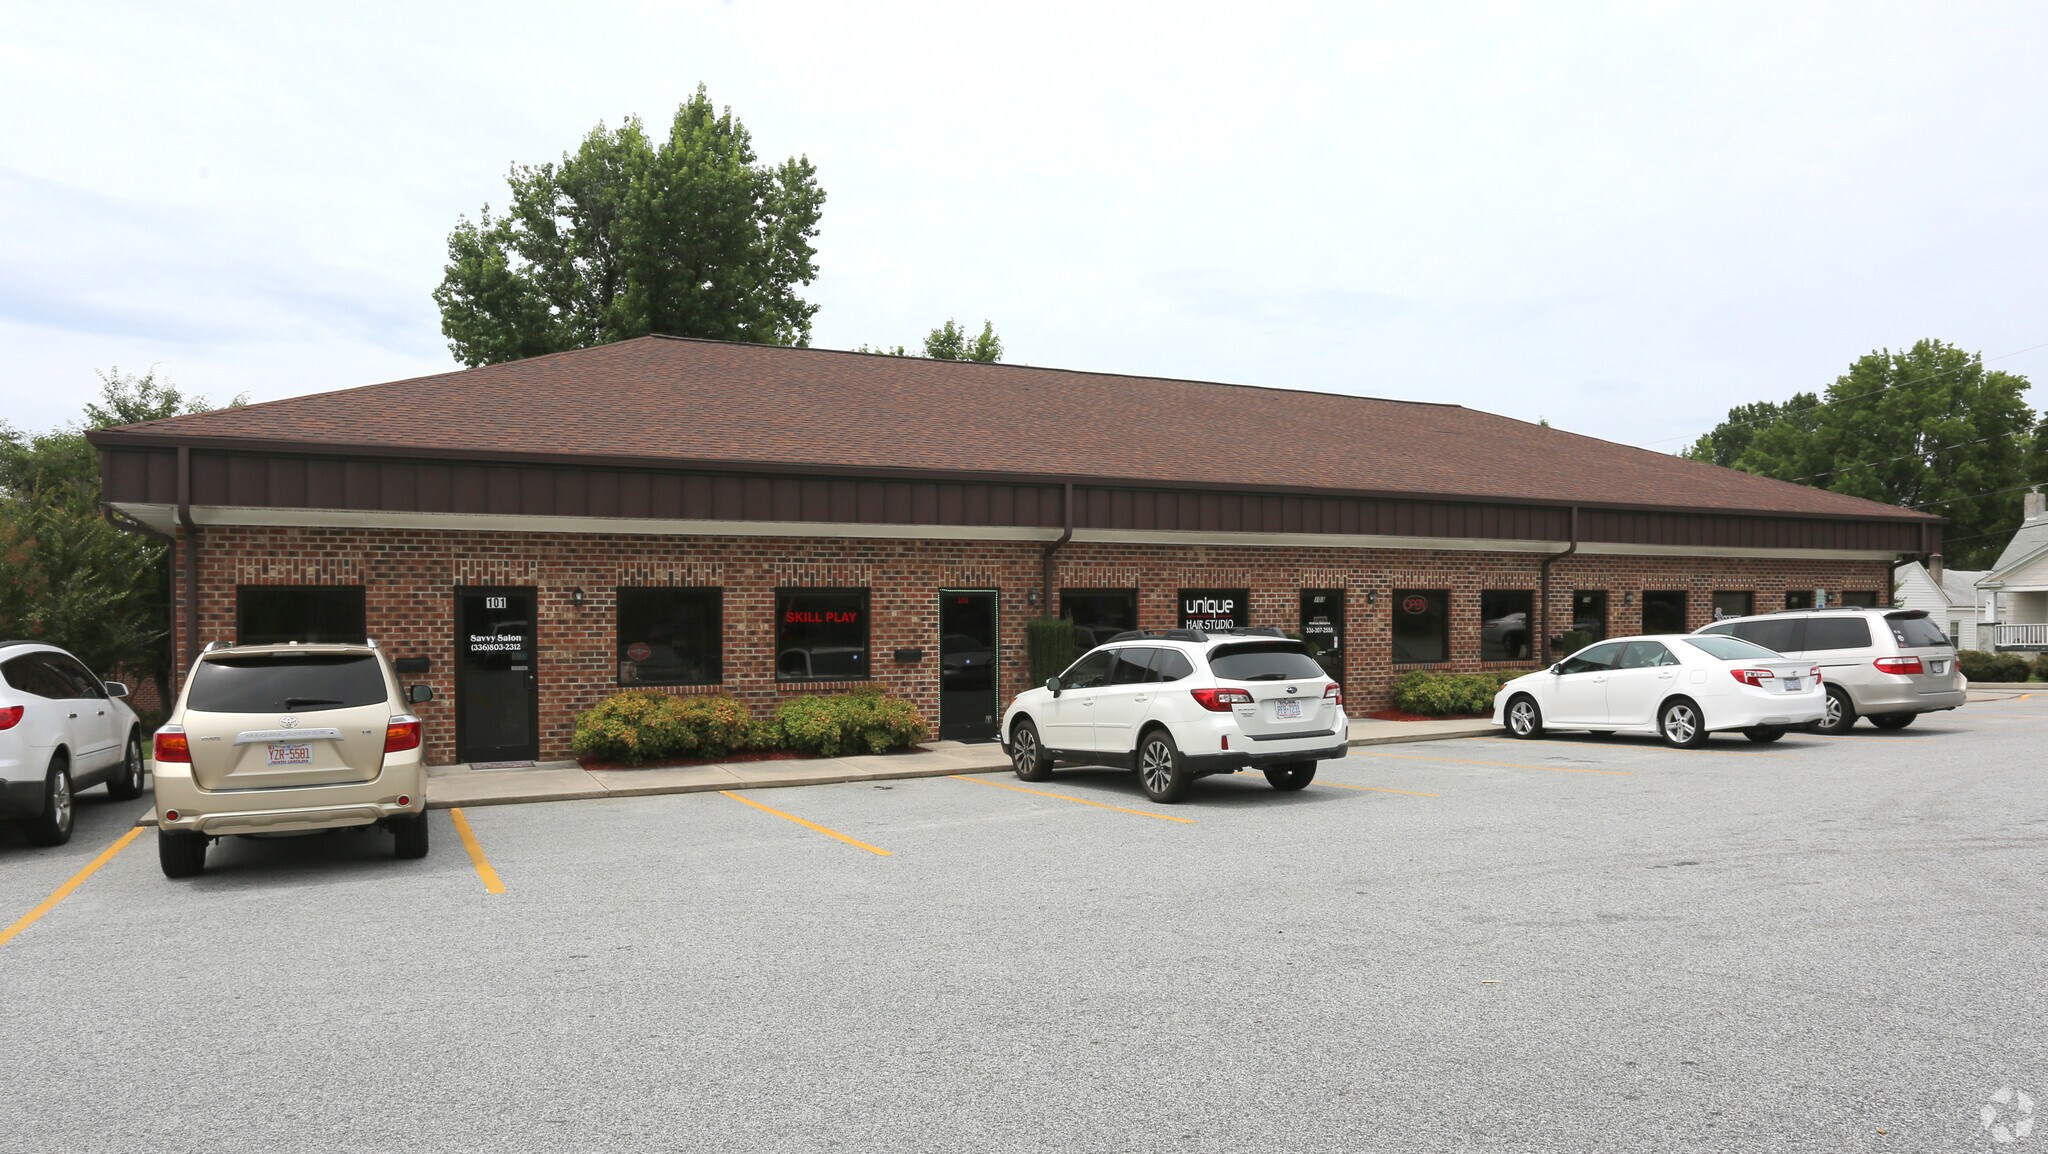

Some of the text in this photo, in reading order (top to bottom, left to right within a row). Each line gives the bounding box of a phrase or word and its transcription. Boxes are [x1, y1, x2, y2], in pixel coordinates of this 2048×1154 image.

[487, 597, 506, 608] 101
[1186, 596, 1234, 619] unique
[787, 612, 857, 622] SKILL PLAY
[1186, 619, 1234, 630] HAIR STUDIO
[470, 634, 522, 643] Savvy Salon
[269, 748, 310, 760] YZR-5581
